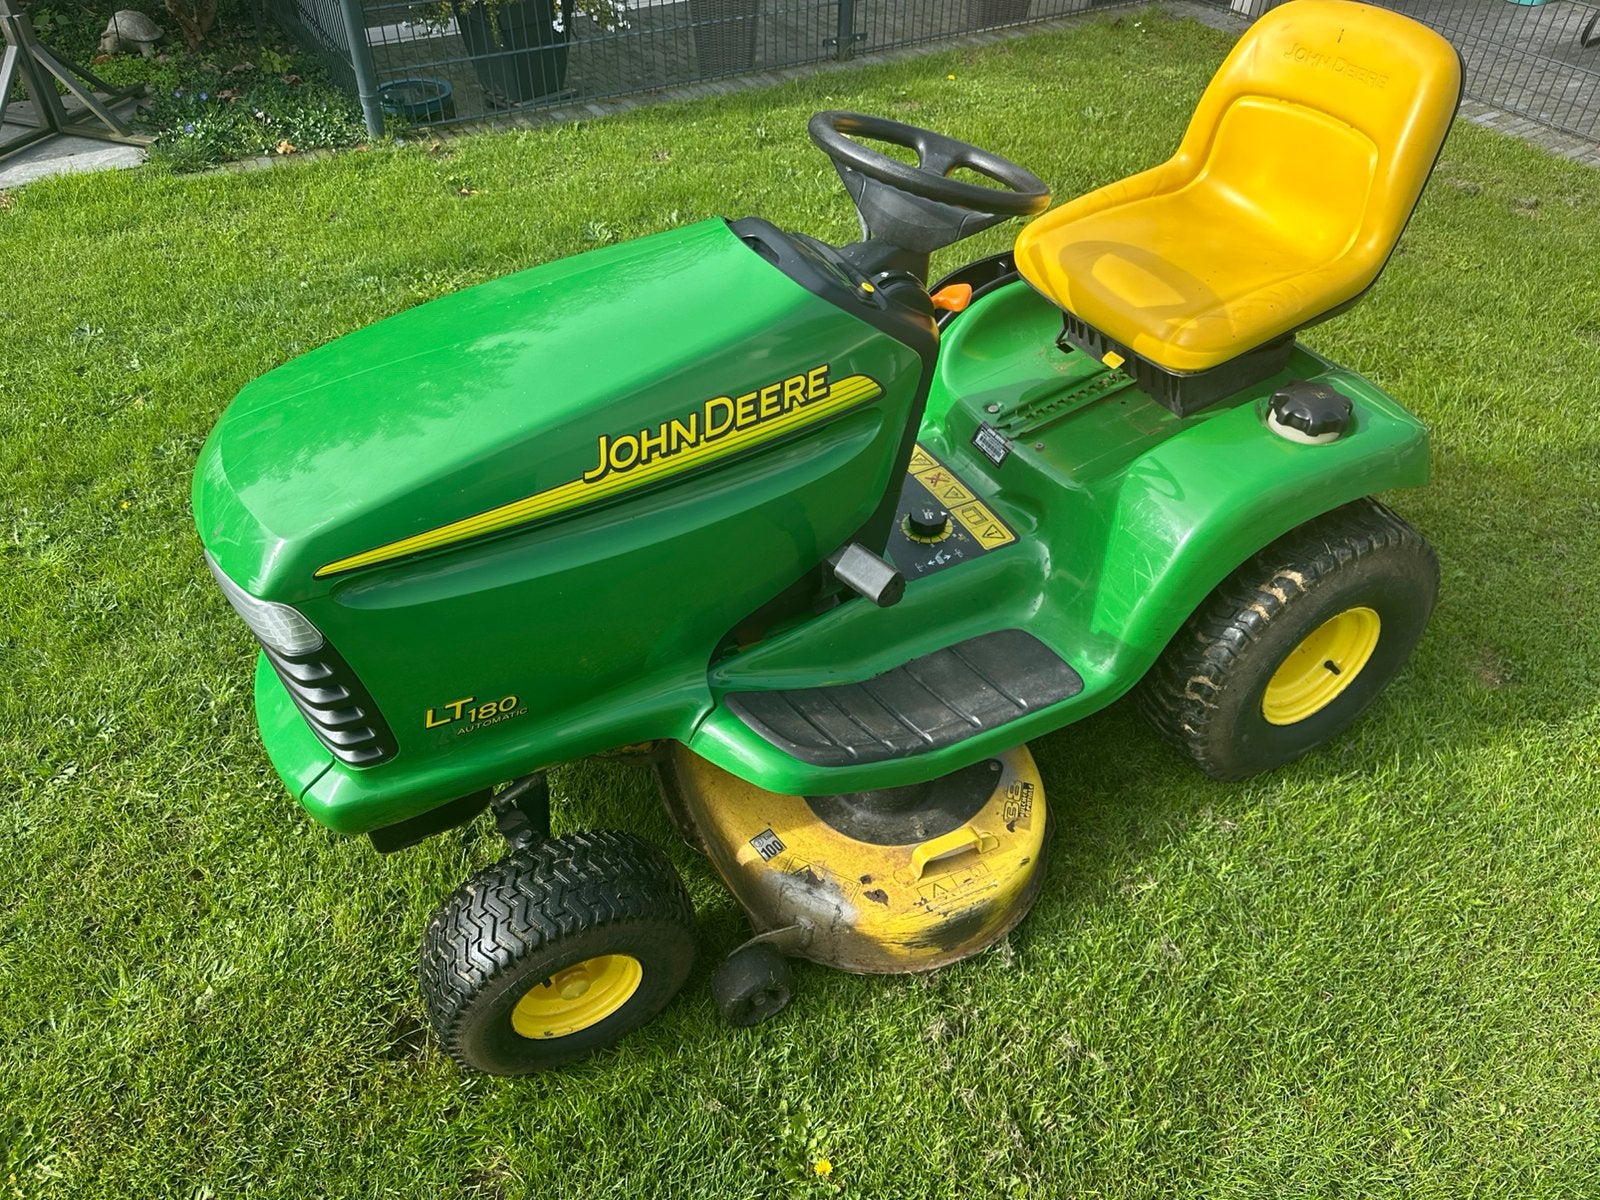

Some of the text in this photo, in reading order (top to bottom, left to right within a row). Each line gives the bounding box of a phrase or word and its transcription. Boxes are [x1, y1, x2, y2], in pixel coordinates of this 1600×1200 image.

[1284, 42, 1390, 88] JOHN DEERE
[583, 364, 830, 482] JOHN DEERE
[457, 708, 528, 735] AUTOMATIC
[1003, 780, 1022, 821] 38
[761, 840, 784, 859] 100
